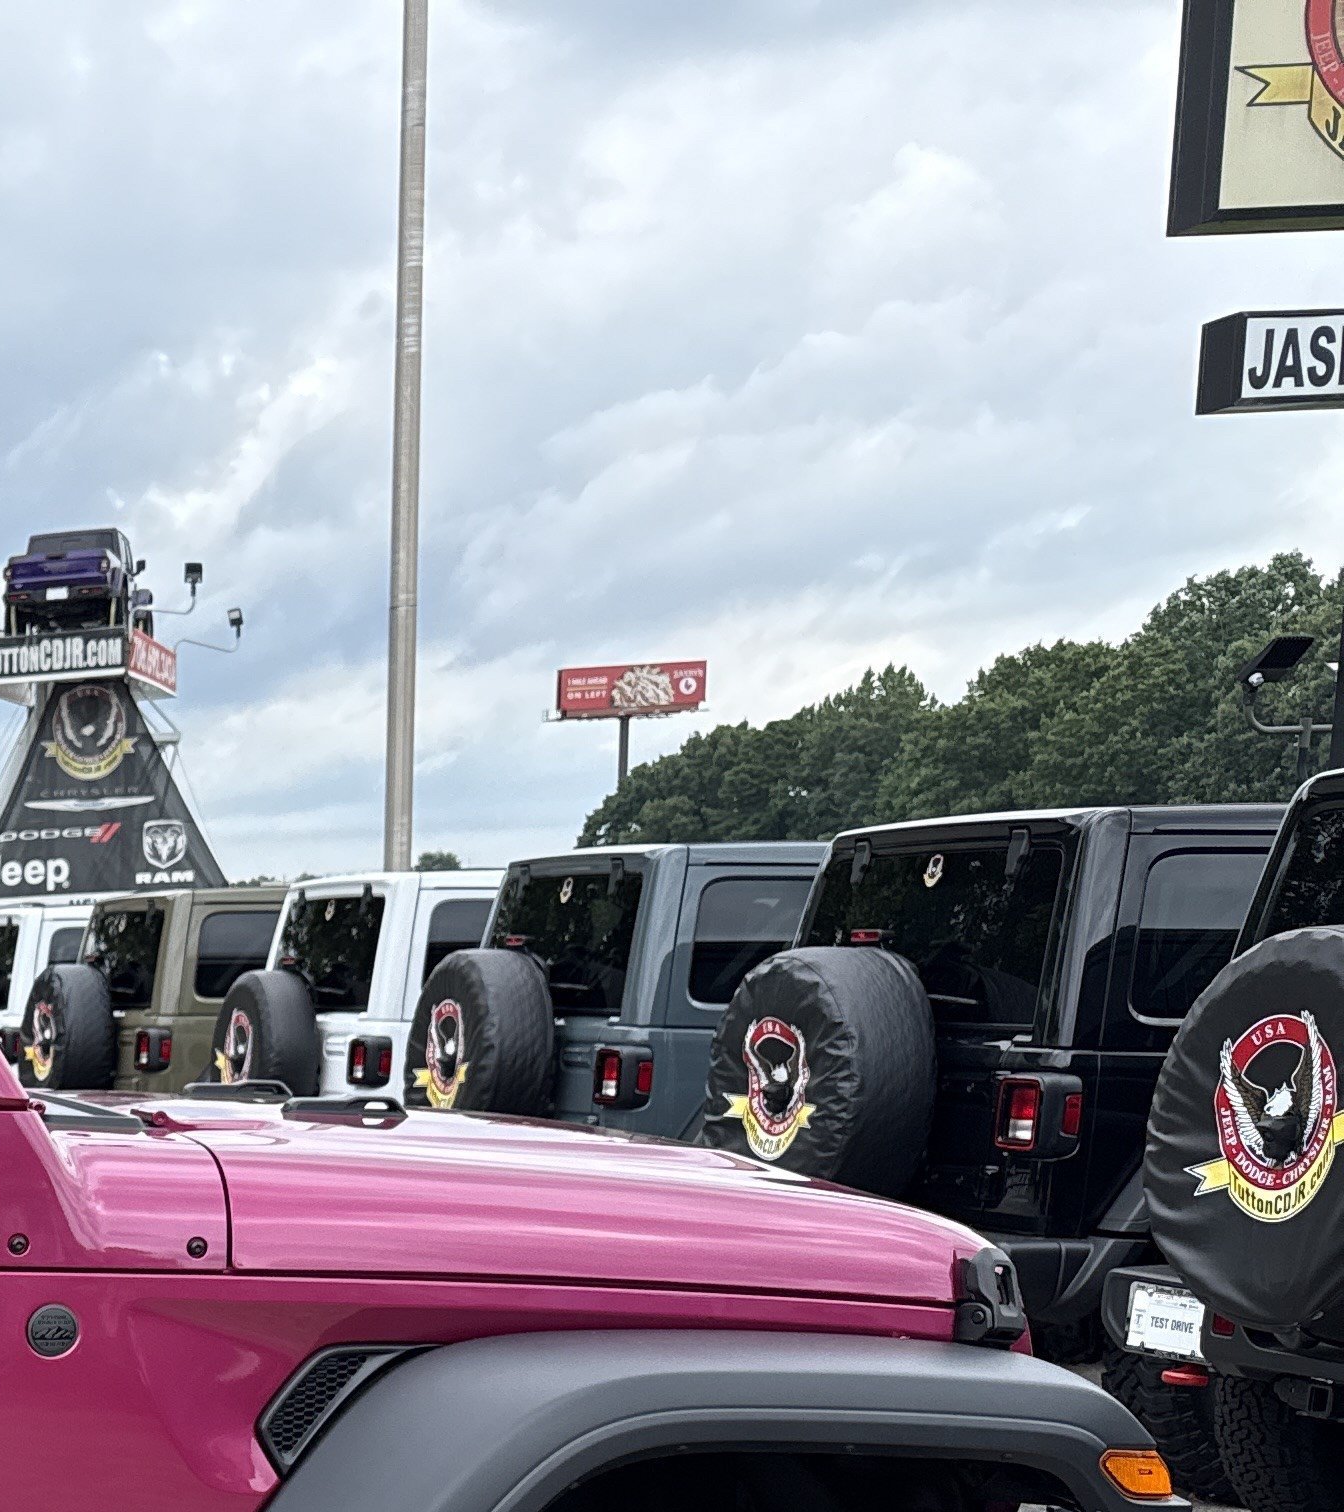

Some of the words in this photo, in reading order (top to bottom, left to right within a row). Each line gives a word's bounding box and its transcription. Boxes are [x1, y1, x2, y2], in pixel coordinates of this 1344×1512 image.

[1312, 31, 1340, 72] JEEP
[1247, 324, 1344, 390] JAS
[135, 869, 196, 885] RAM
[1251, 1021, 1286, 1046] USA
[1220, 1107, 1237, 1147] JEEP
[1234, 1154, 1275, 1187] DODGE
[1281, 1117, 1331, 1186] CHRYSLER
[1322, 1065, 1333, 1106] RAM
[1231, 1140, 1333, 1216] TuttonCDJR.com
[1150, 1316, 1169, 1329] TEST
[1171, 1320, 1194, 1334] DRIVE
